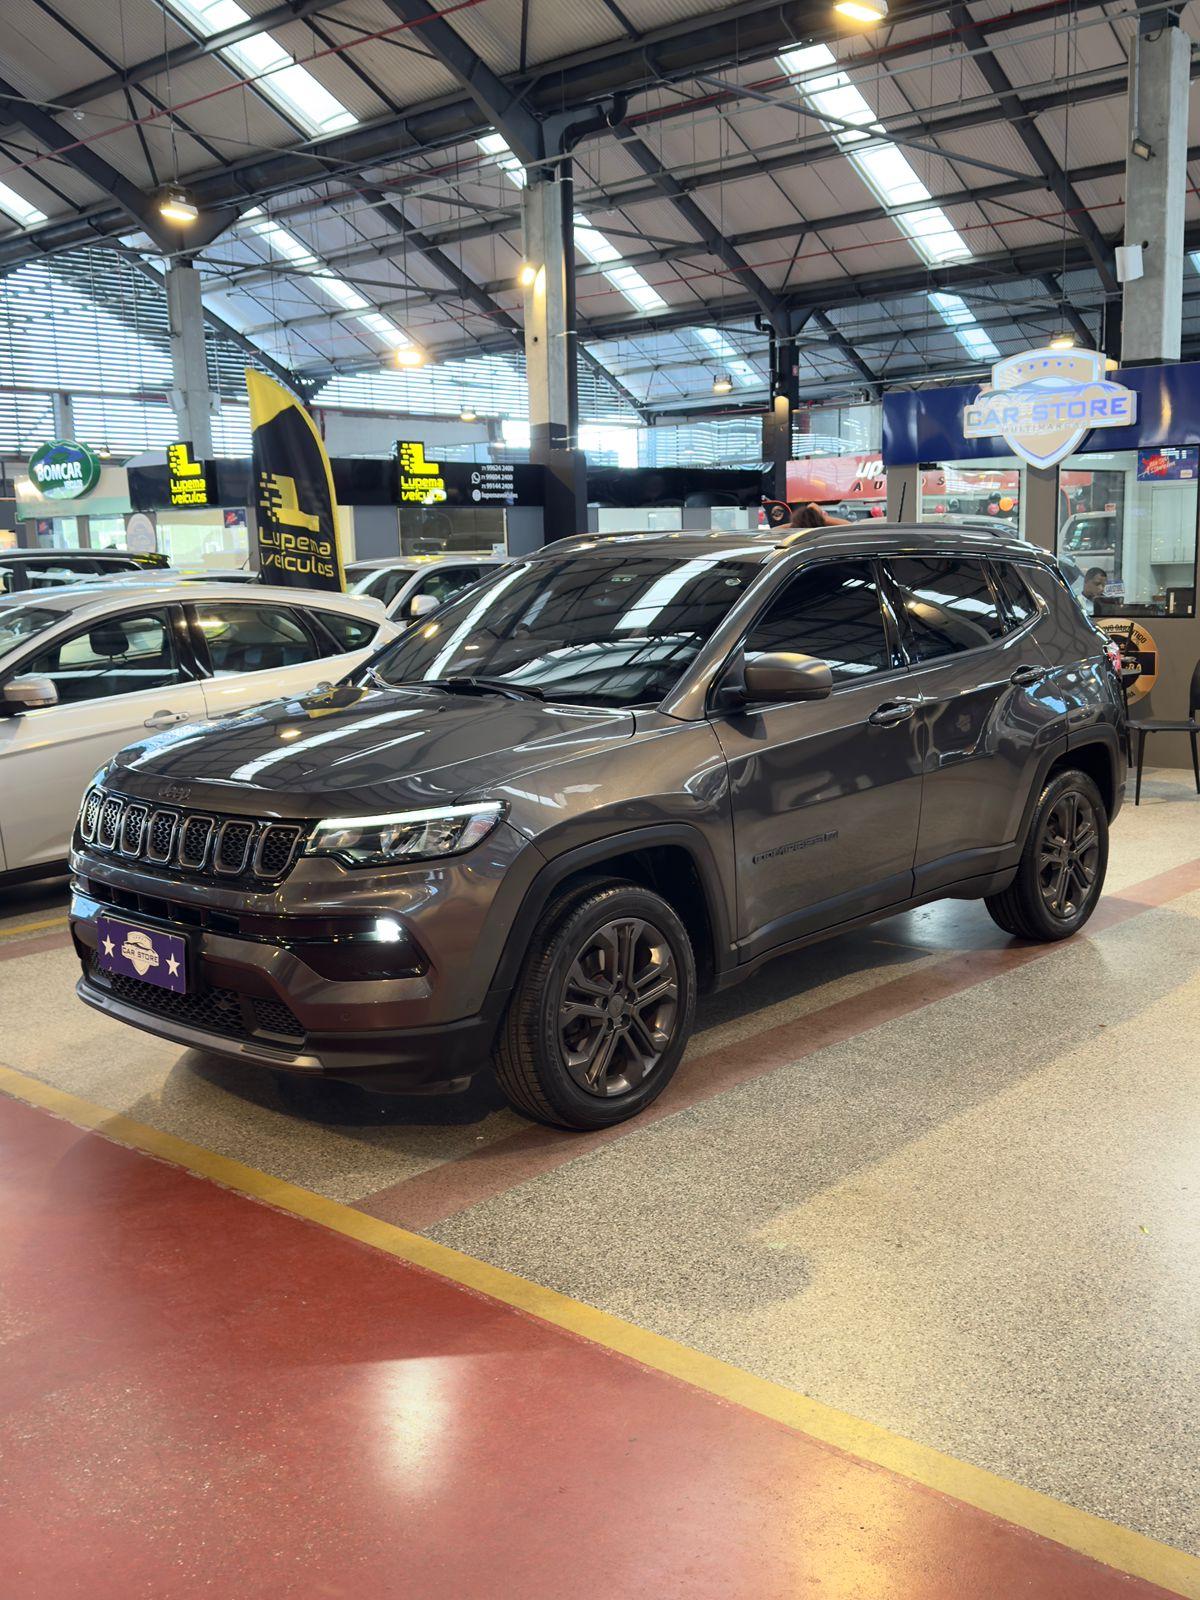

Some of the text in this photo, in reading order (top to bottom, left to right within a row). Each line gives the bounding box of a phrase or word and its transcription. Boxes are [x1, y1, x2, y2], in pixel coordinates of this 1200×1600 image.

[966, 397, 1128, 427] CAR STORE
[35, 461, 83, 482] BOMCAR
[170, 478, 206, 492] Lupema
[400, 475, 444, 490] Lupema
[171, 491, 208, 505] veículos
[258, 526, 332, 556] Lupema
[122, 946, 159, 964] CAR STORE
